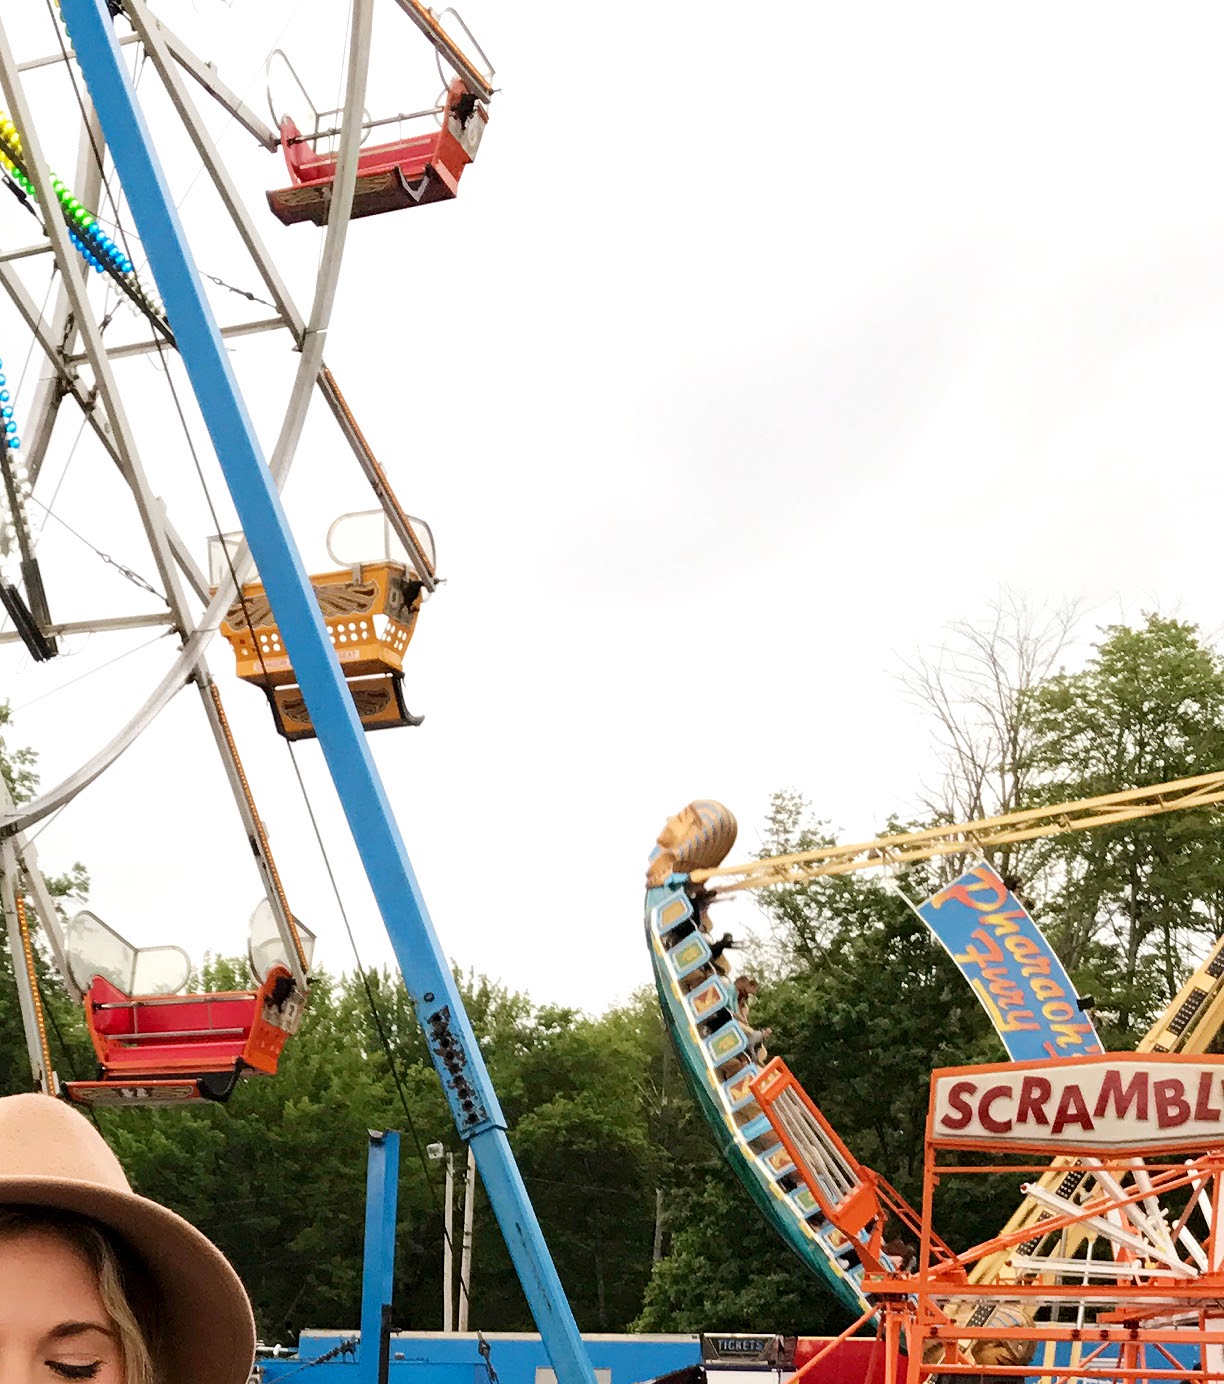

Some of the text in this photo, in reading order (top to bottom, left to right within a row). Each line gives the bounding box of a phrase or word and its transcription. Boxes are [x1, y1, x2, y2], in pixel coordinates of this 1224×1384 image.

[931, 867, 1100, 1058] Pharaoh'
[954, 928, 1041, 1032] Fury
[940, 1070, 1224, 1134] SCRAMBL
[717, 1340, 764, 1351] TICKETS
